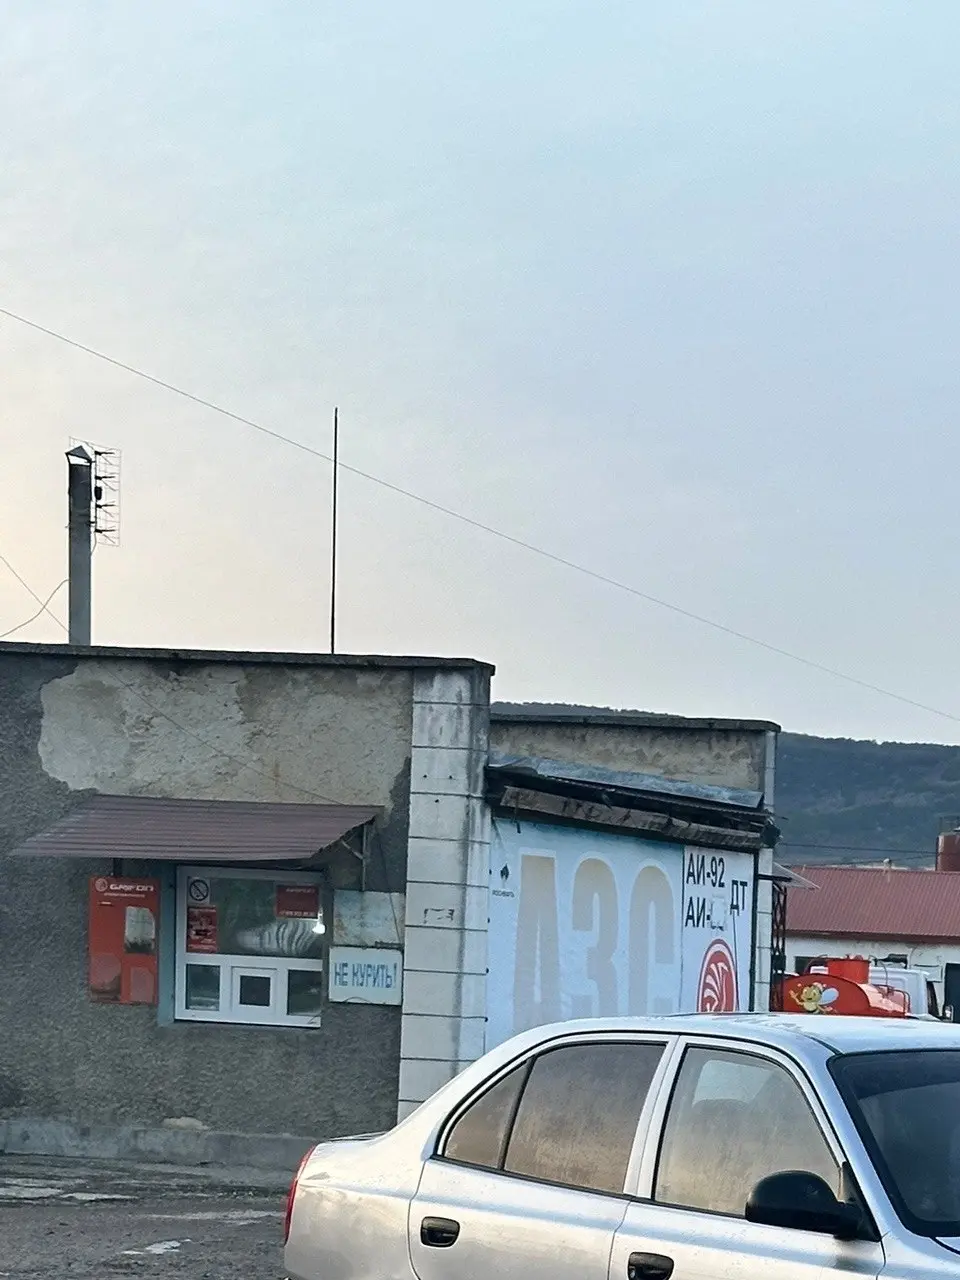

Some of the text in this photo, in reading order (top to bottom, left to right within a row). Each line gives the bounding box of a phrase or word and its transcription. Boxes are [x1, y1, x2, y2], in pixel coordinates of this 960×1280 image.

[686, 853, 725, 888] АИ-92
[685, 896, 725, 931] АИ-
[730, 880, 748, 916] ДТ
[513, 853, 675, 1032] АЗС
[334, 962, 397, 988] НЕ КУРИТЬ!
